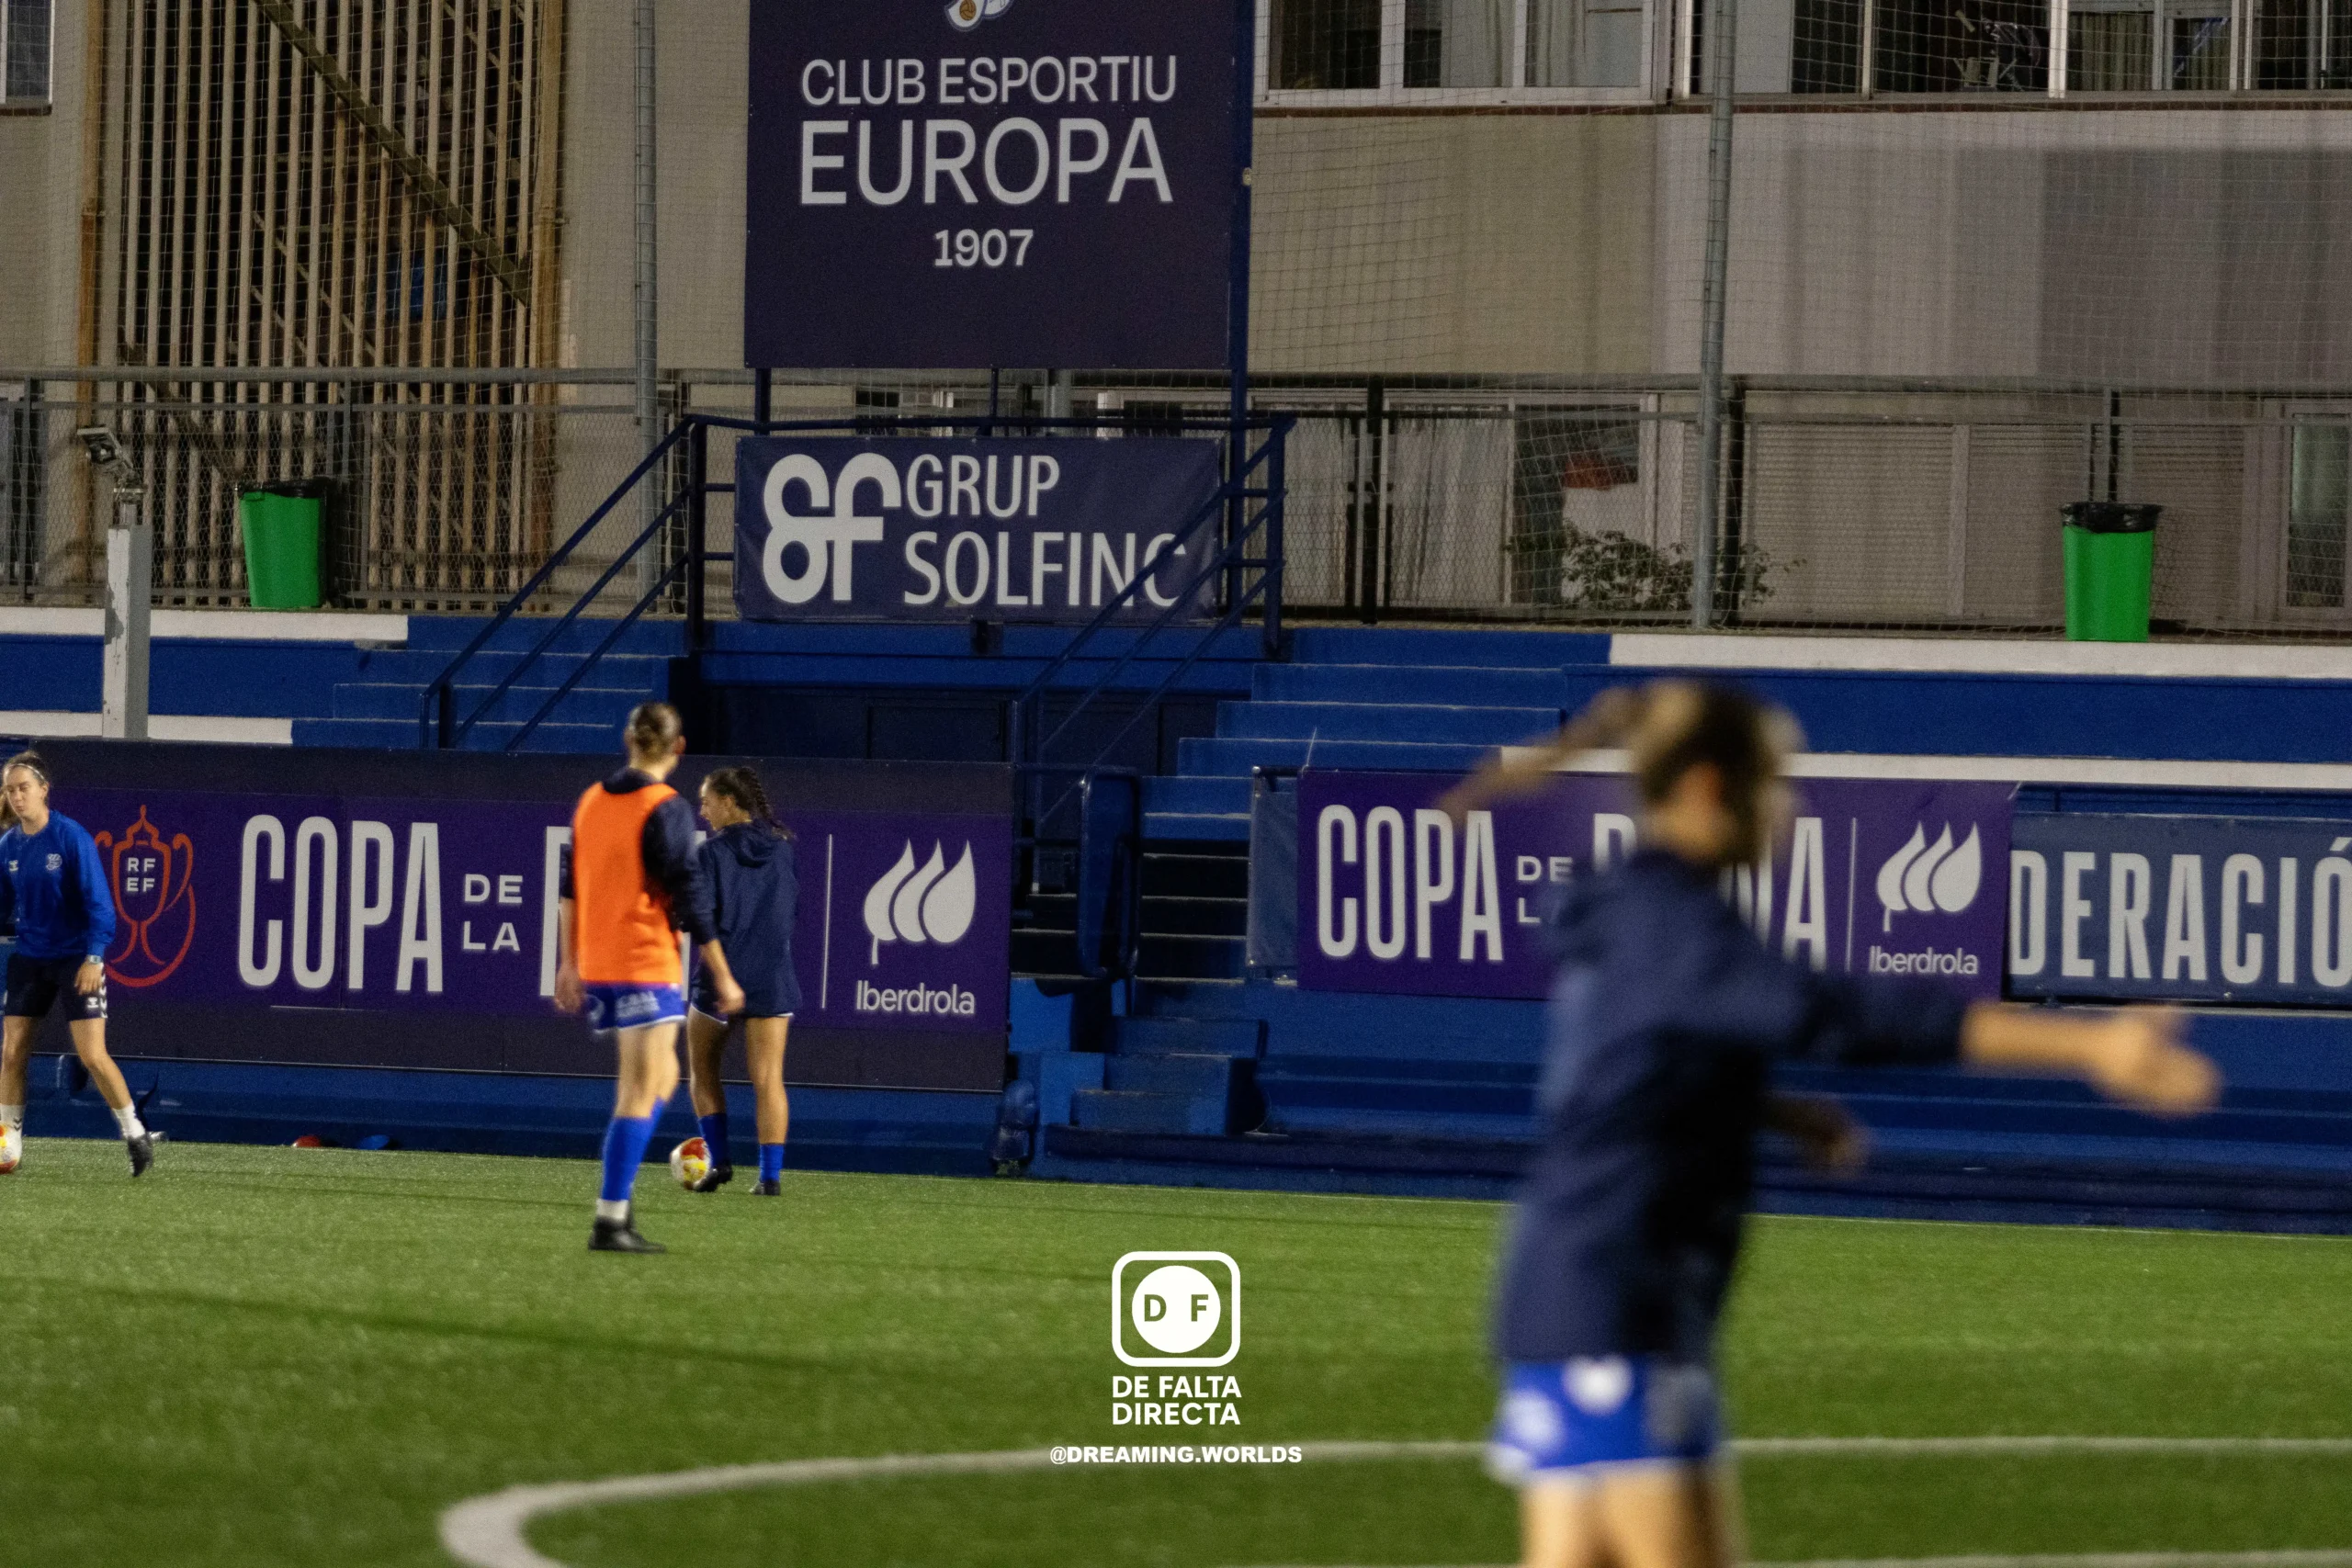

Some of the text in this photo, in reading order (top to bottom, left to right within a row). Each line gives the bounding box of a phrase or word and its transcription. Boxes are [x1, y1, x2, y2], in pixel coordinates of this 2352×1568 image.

[801, 56, 1176, 106] CLUB ESPORTIU
[801, 117, 1173, 206] EUROPA
[933, 228, 1034, 267] 1907
[906, 454, 1060, 517] GRUP
[903, 532, 1187, 608] SOLFINC
[464, 874, 524, 905] DE
[1317, 804, 1503, 962] COPA
[1517, 855, 1574, 883] DE
[238, 814, 443, 993] COPA
[462, 920, 521, 952] LA
[1869, 945, 1979, 976] Iberdrola
[855, 979, 976, 1015] Iberdrola
